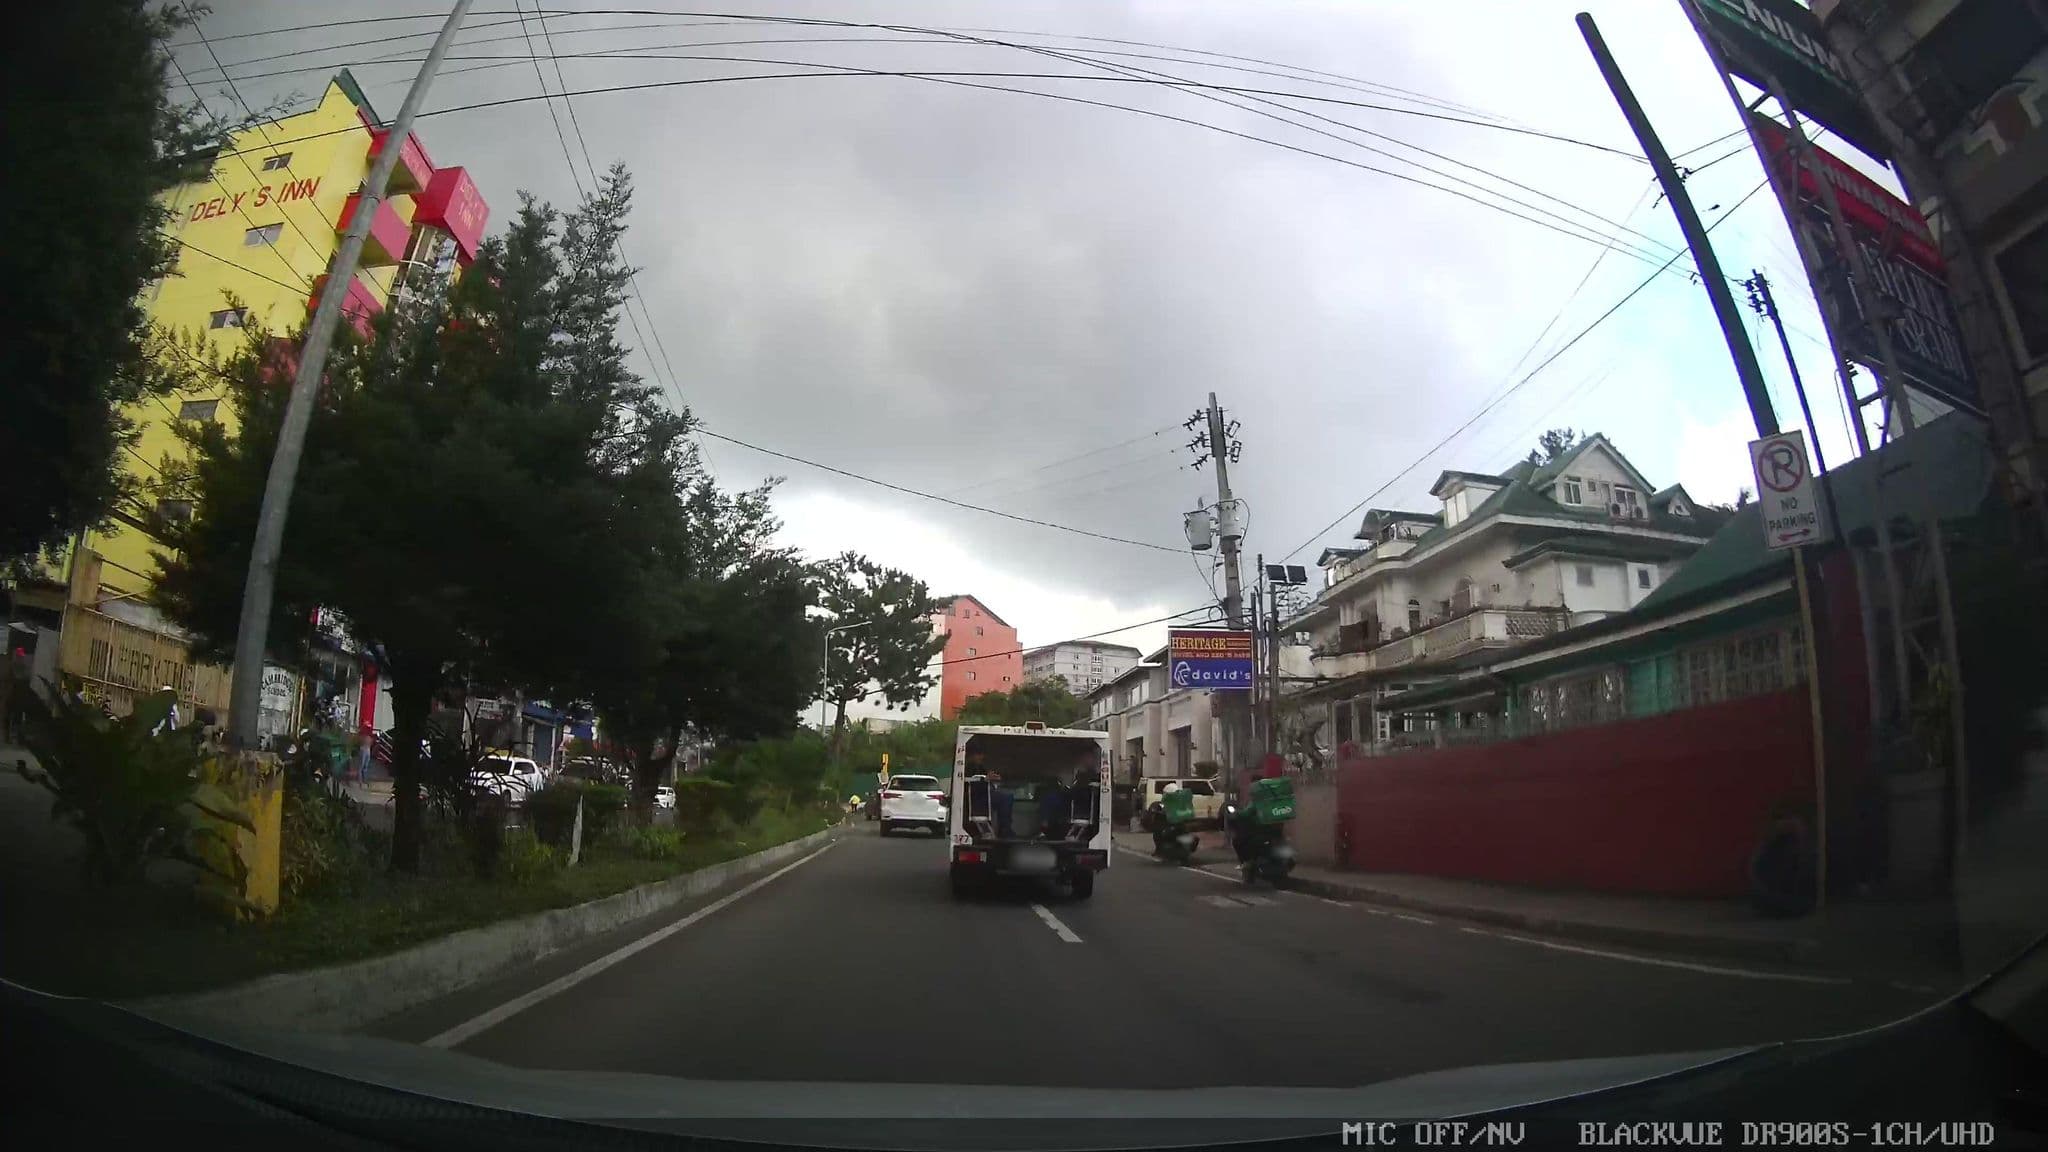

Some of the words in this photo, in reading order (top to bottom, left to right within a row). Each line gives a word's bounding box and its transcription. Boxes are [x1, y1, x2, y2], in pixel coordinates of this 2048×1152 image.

[191, 186, 272, 222] DELY'S
[277, 176, 322, 204] INN
[1780, 497, 1799, 510] NO
[1769, 512, 1816, 531] PARKING
[1171, 636, 1226, 650] HERITAGE
[1191, 669, 1251, 680] david's
[1271, 806, 1293, 816] Grab
